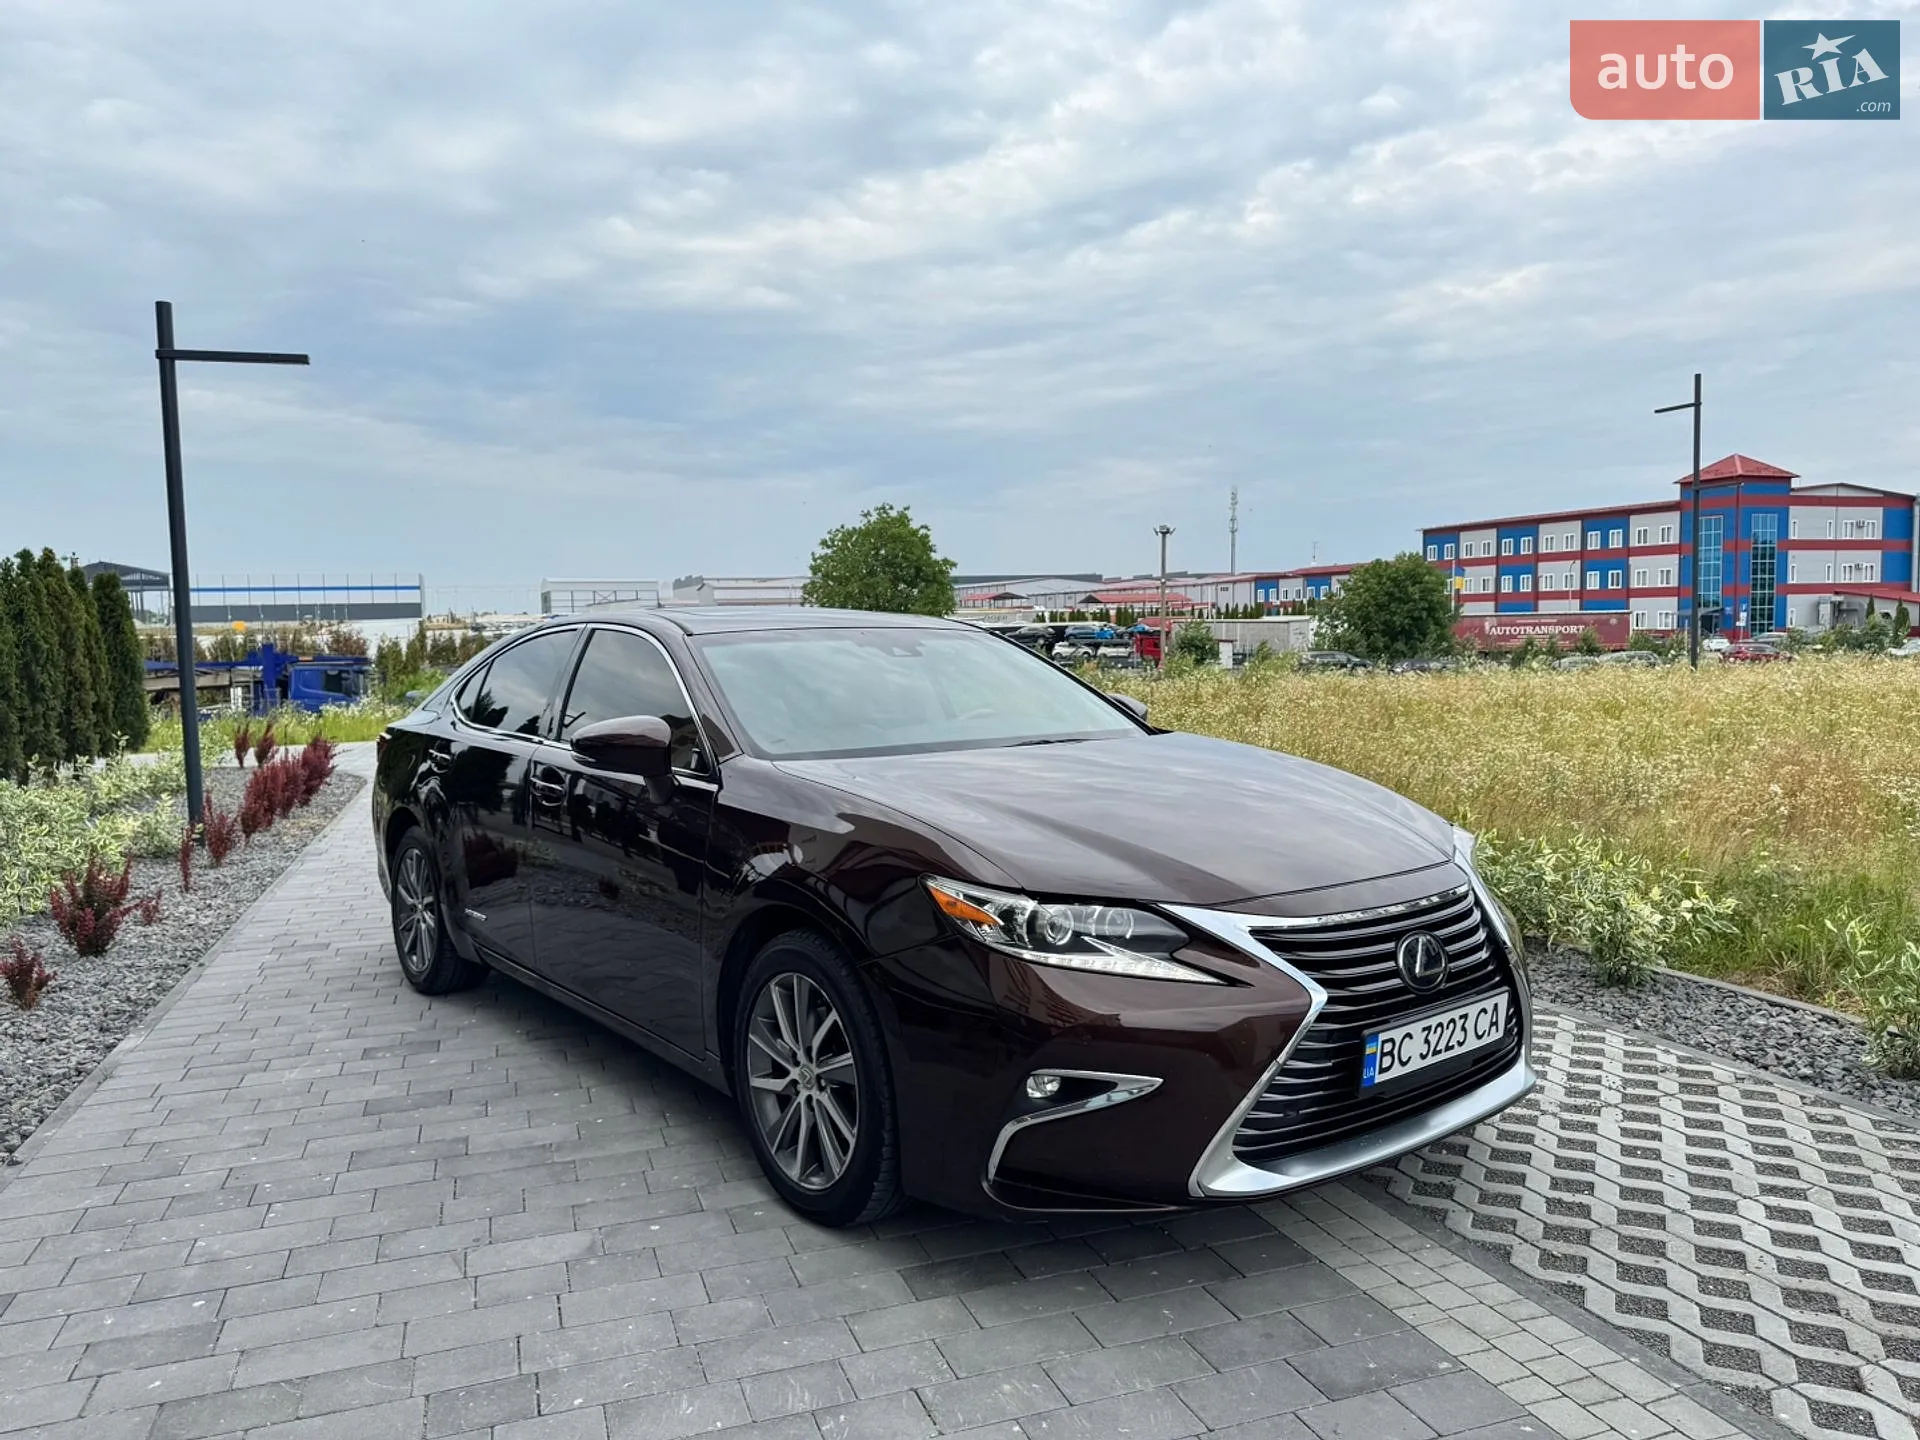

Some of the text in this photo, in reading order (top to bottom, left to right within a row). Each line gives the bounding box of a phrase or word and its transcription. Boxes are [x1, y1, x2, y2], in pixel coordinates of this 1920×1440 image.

[1489, 625, 1585, 636] AUTOTRANSPORT
[1378, 1002, 1499, 1075] BC 3223 CA
